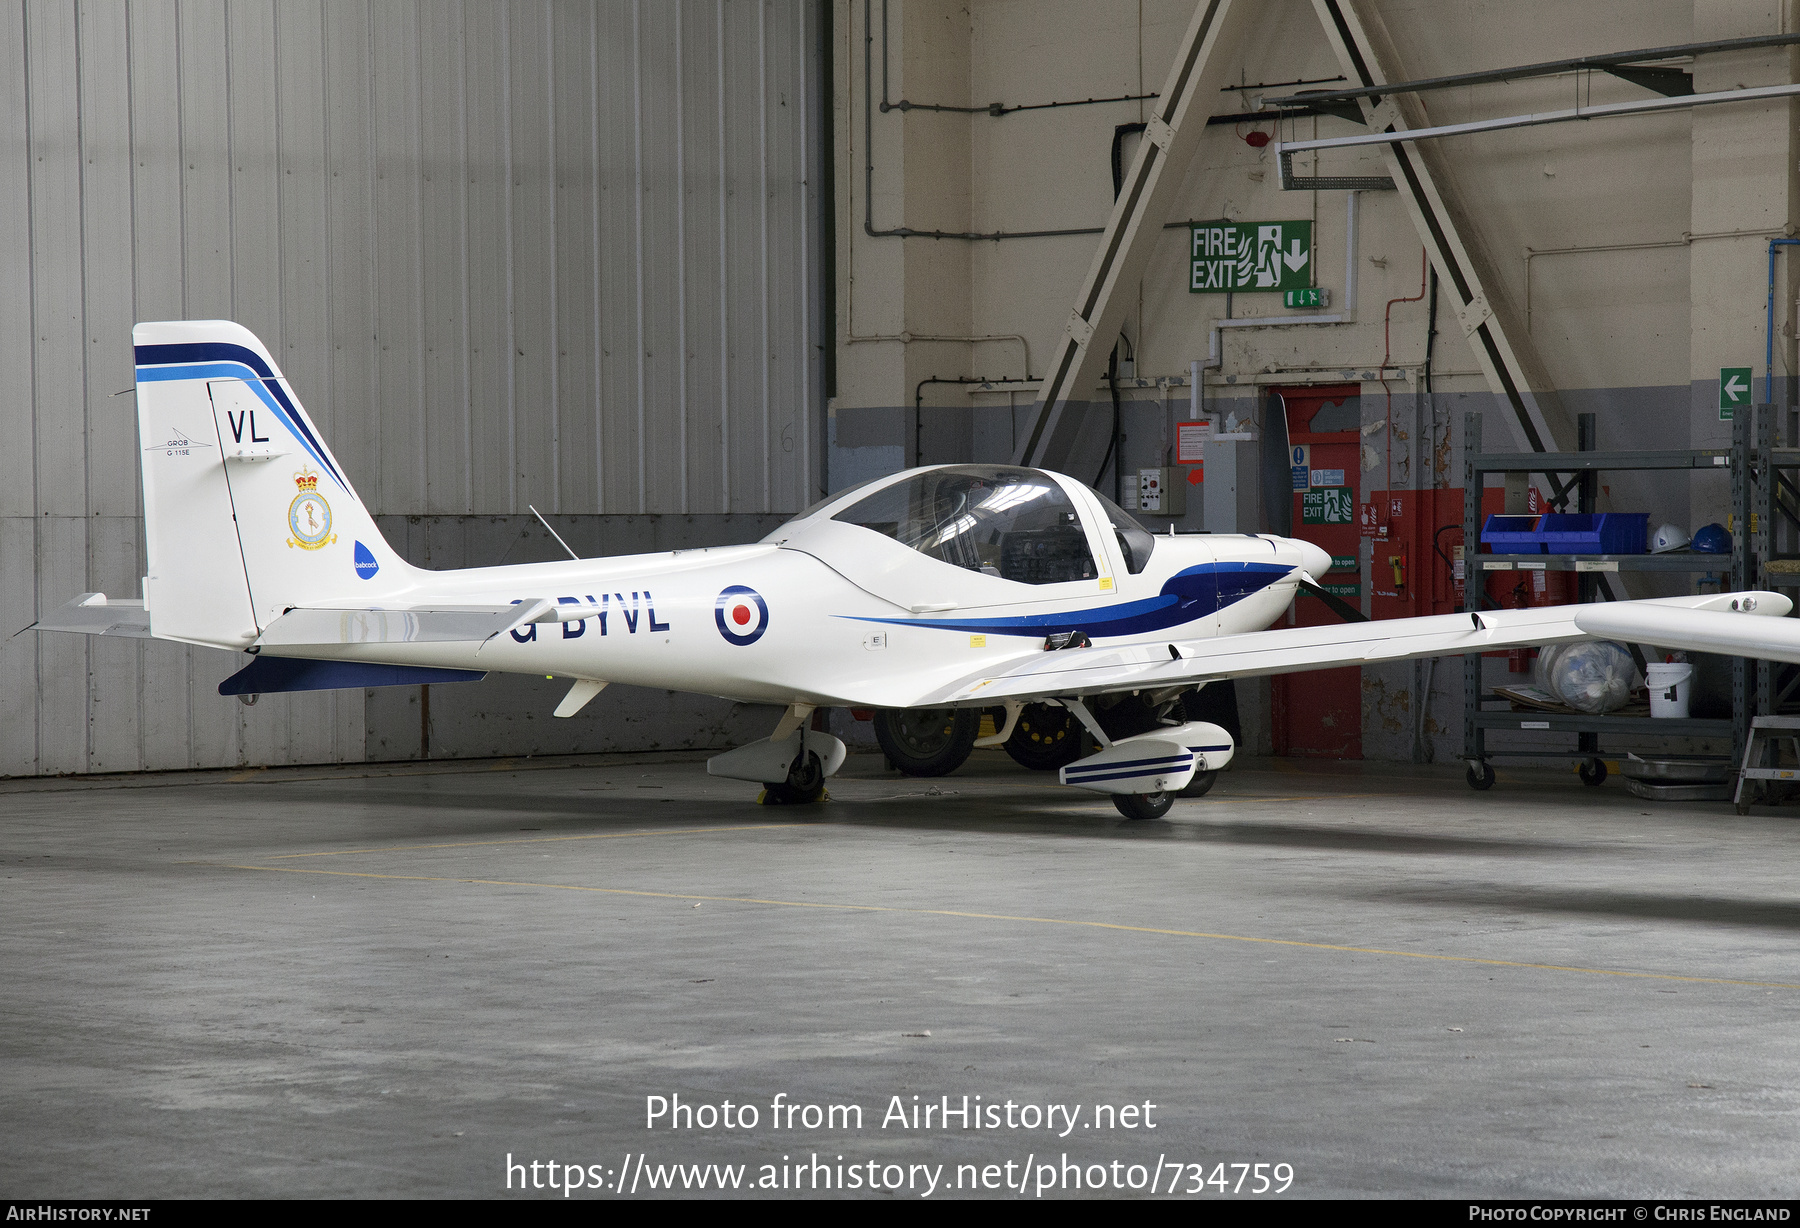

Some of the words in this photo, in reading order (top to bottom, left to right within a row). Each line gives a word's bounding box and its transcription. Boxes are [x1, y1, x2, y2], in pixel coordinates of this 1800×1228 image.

[1193, 227, 1237, 256] FIRE
[1192, 260, 1237, 289] EXIT
[227, 410, 270, 444] VL
[167, 439, 189, 447] GROB
[167, 449, 173, 457] G
[1303, 493, 1323, 504] FIRE
[1303, 507, 1323, 518] EXIT
[355, 561, 378, 569] babcock
[1341, 559, 1355, 567] open
[1340, 587, 1356, 595] open
